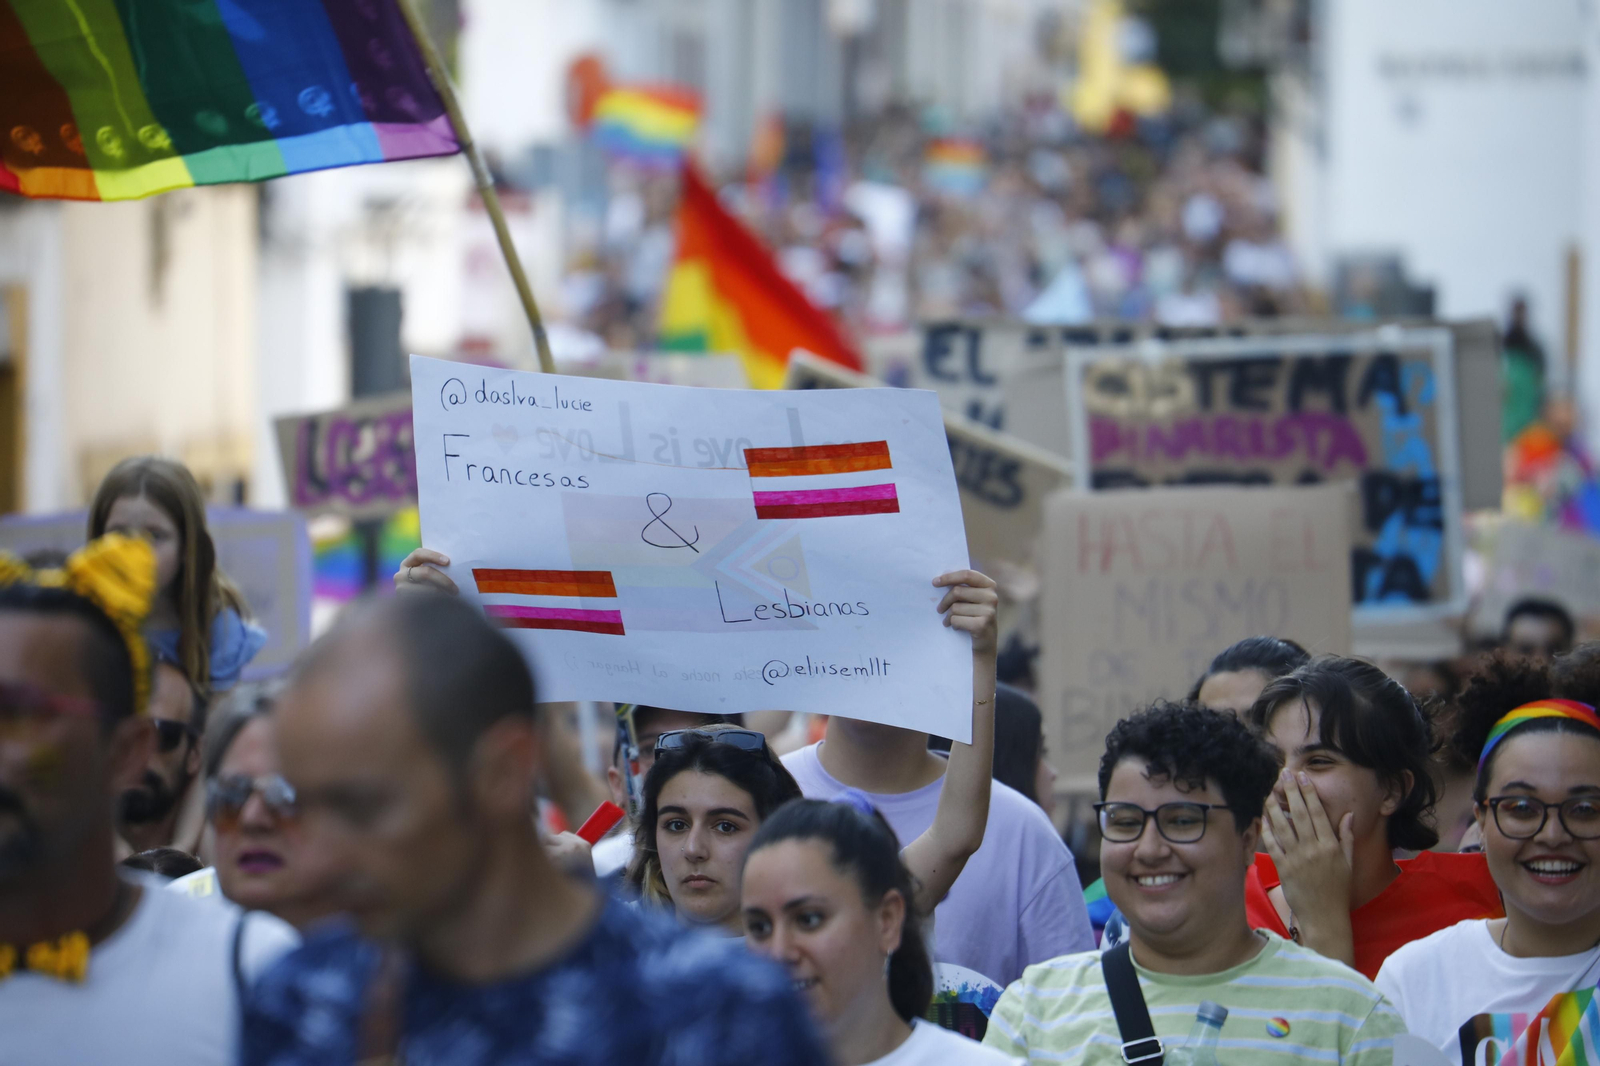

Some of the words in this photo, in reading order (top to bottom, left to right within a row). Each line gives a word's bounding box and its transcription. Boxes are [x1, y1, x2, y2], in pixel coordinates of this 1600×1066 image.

[923, 323, 997, 385] EL
[443, 433, 590, 489] Francesas
[641, 492, 700, 553] &
[1075, 507, 1240, 575] HASTA
[1268, 507, 1328, 574] EL
[715, 580, 870, 623] Lesbianas
[1112, 576, 1292, 644] MISMO
